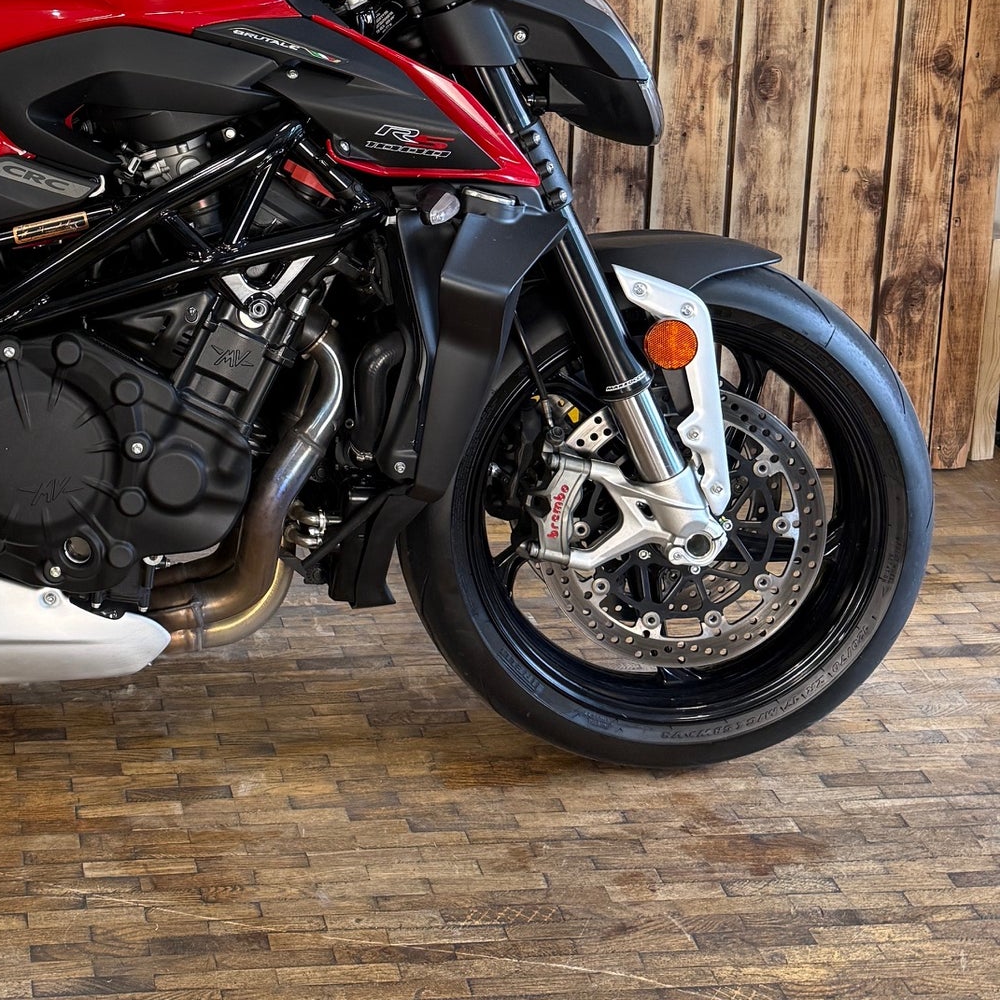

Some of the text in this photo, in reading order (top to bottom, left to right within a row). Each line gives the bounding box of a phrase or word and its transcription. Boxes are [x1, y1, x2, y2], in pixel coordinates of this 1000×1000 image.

[232, 29, 300, 51] BRUTALE
[374, 124, 456, 150] RS
[2, 166, 70, 191] CRC
[547, 484, 570, 540] brembo
